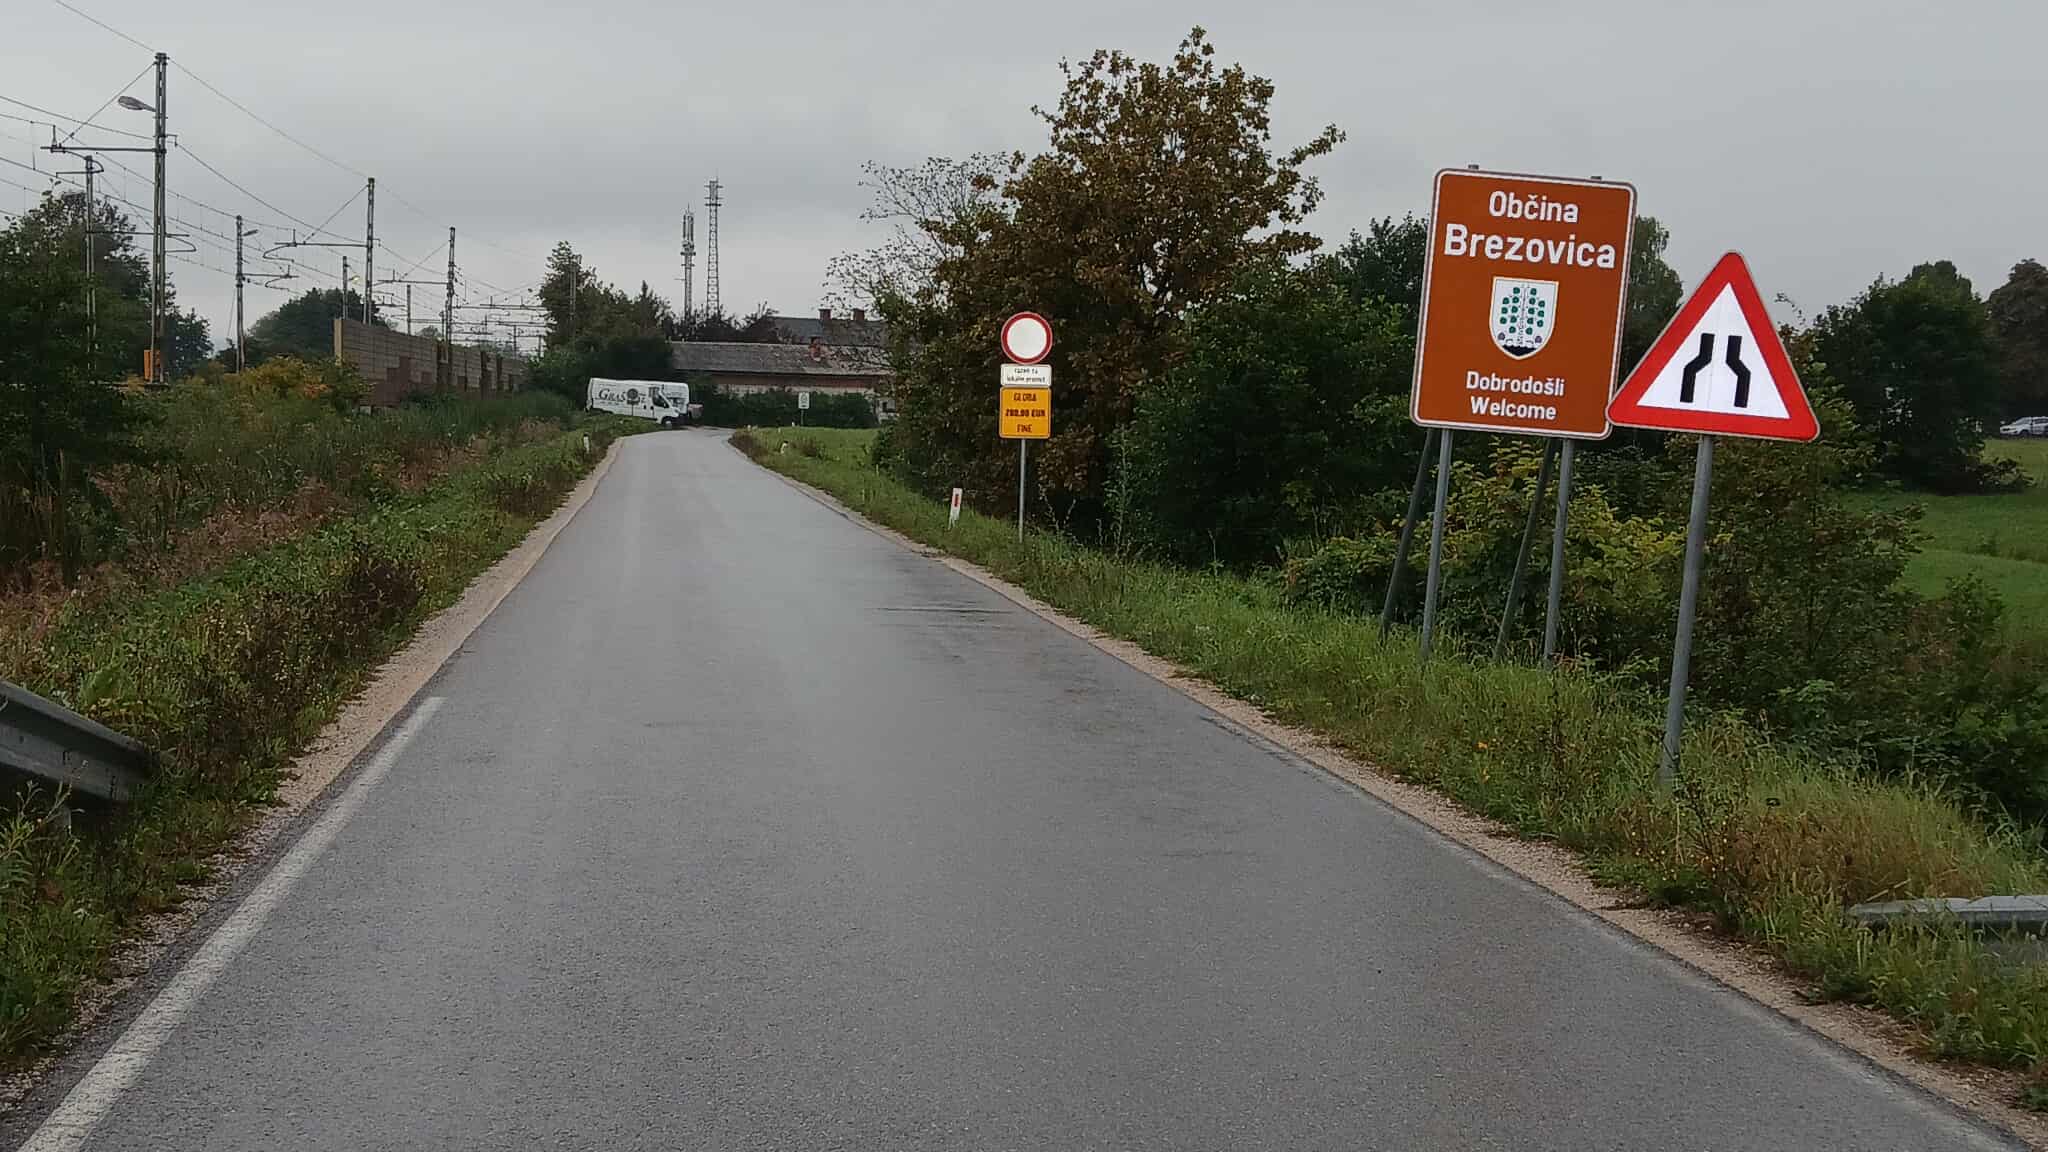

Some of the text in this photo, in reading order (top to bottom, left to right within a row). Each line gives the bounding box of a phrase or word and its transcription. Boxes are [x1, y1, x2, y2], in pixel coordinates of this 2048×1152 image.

[1488, 190, 1580, 223] Občina
[1444, 223, 1617, 269] Brezovica
[1466, 370, 1565, 396] Dobrodošli
[1470, 396, 1557, 420] Welcome
[1016, 423, 1033, 433] FINE
